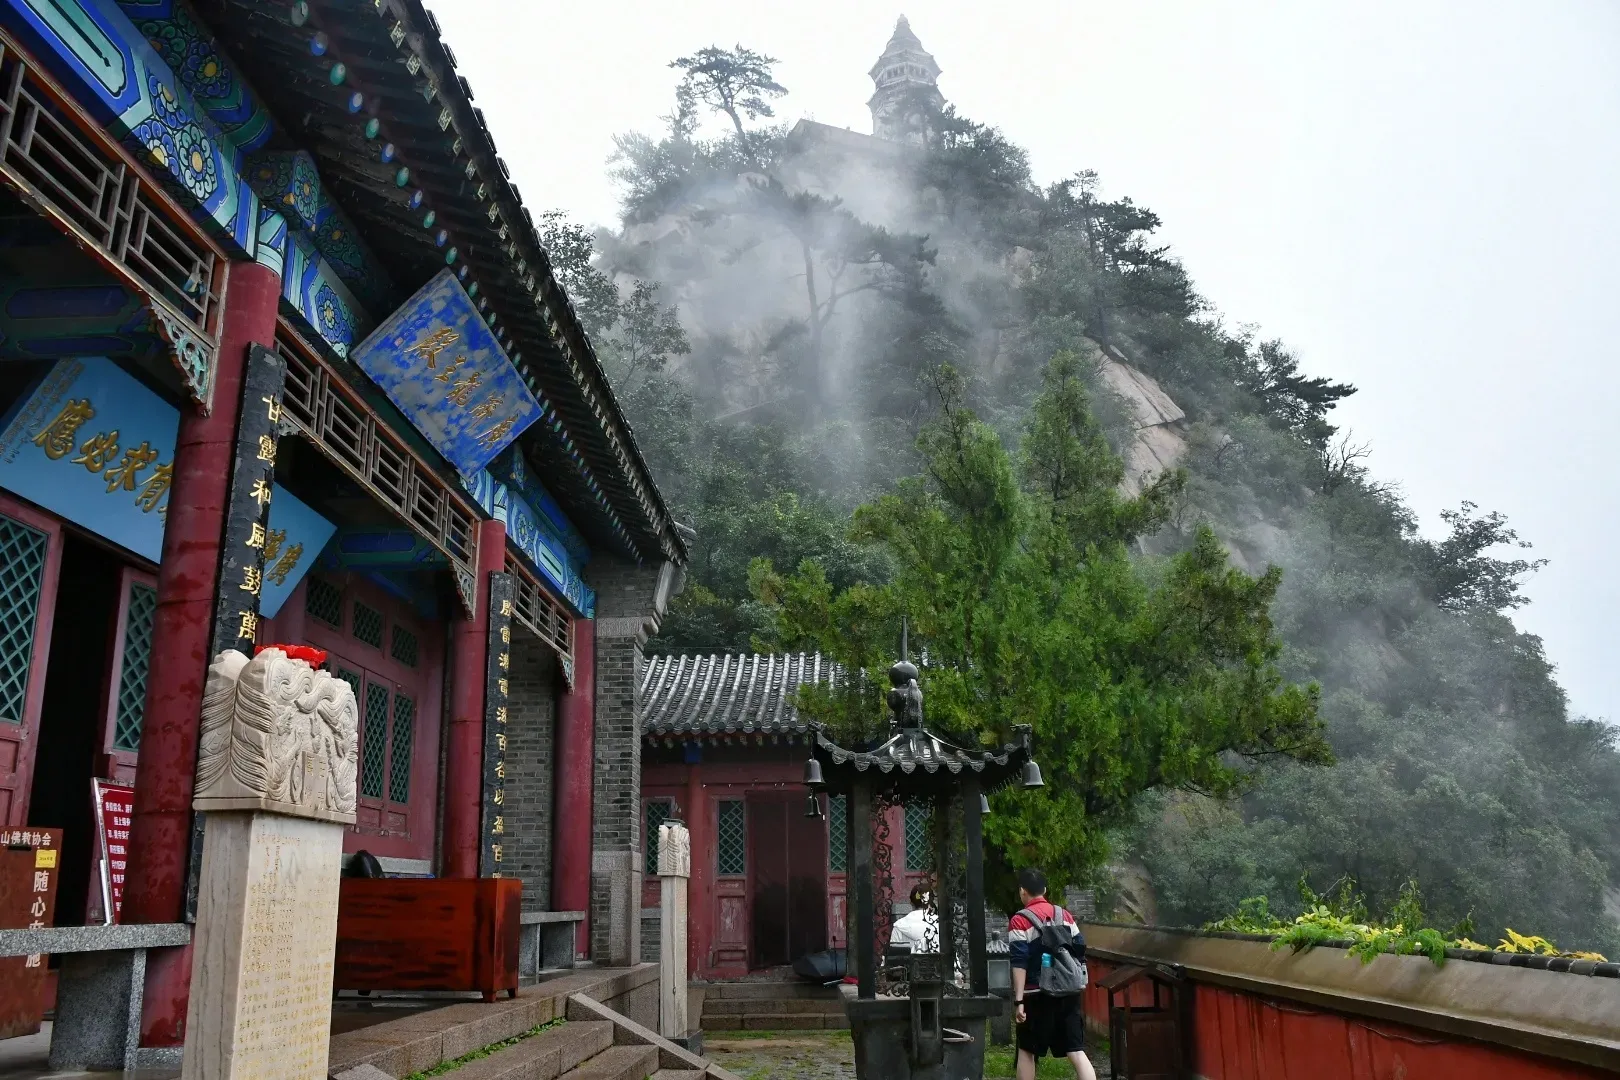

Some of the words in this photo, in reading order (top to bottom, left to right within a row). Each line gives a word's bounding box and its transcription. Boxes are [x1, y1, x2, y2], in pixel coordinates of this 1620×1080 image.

[0, 830, 52, 847] 山佛教协会
